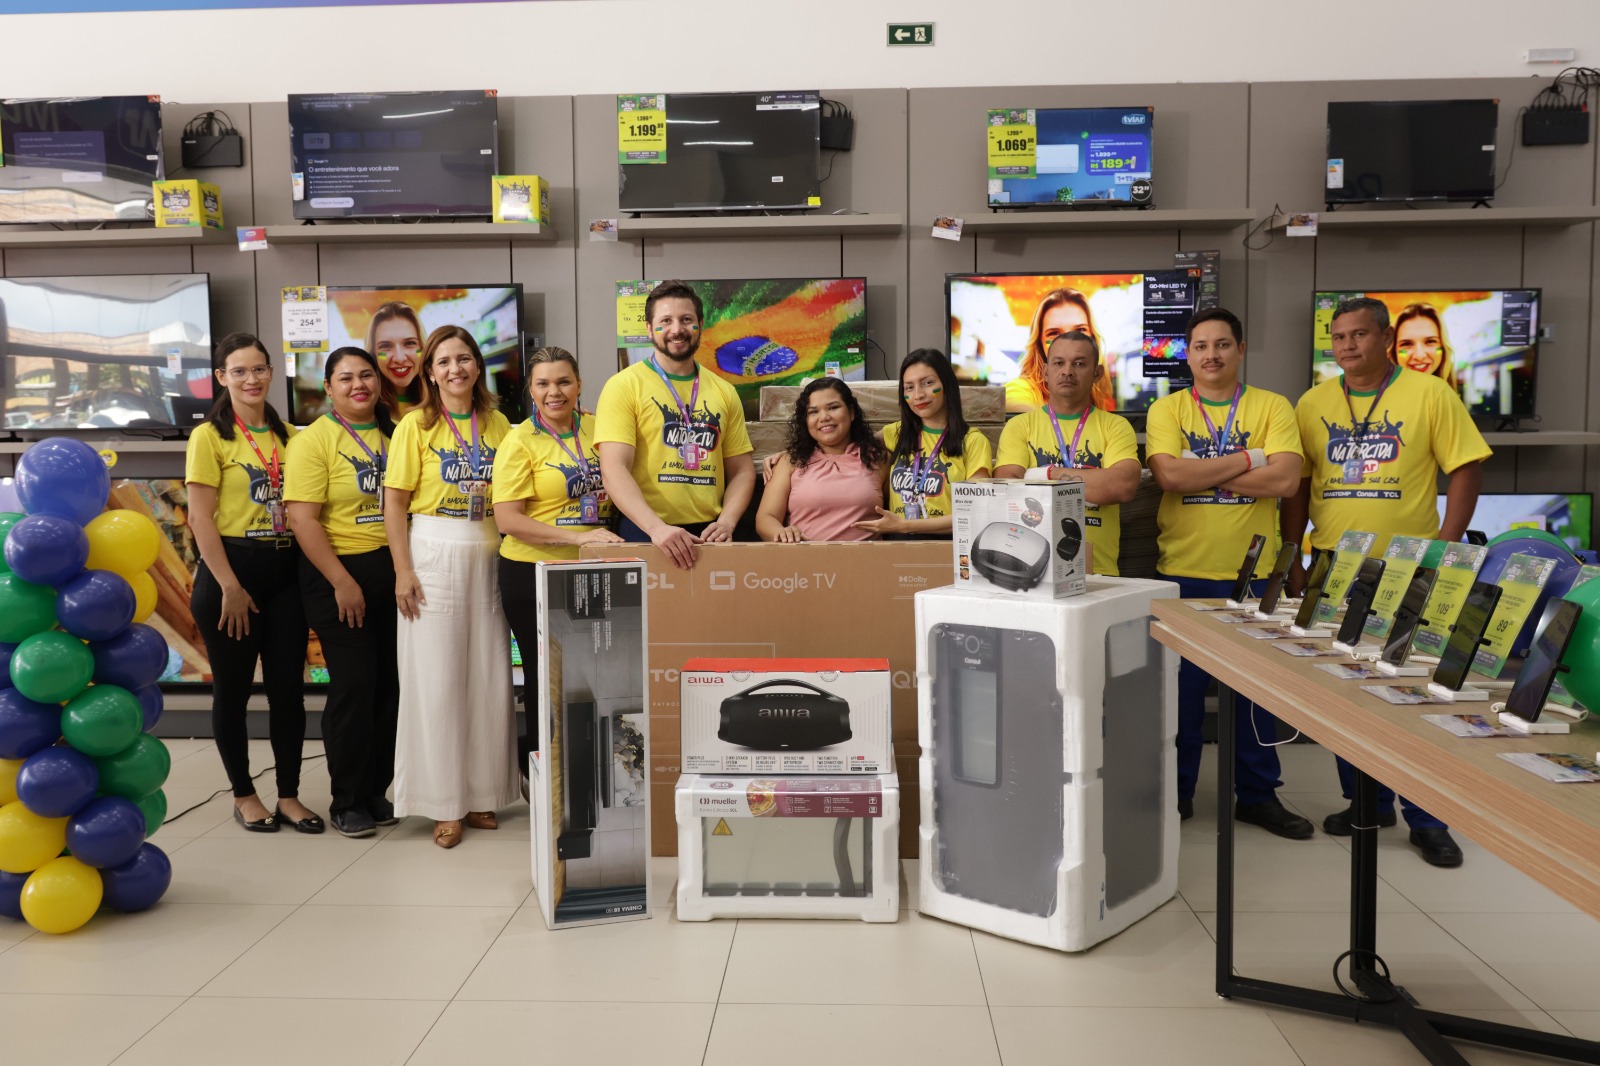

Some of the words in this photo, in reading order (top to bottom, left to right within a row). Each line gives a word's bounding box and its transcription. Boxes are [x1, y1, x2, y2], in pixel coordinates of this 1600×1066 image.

[629, 124, 656, 136] 1.199
[996, 139, 1027, 152] 1.069
[1101, 158, 1123, 169] 189
[445, 464, 460, 481] NA
[363, 474, 376, 491] NA
[255, 484, 268, 501] NA
[955, 487, 996, 497] MONDIAL
[1058, 488, 1081, 497] MONDIAL
[646, 572, 674, 590] CL
[744, 572, 808, 594] Google
[813, 573, 837, 588] TV
[1381, 589, 1394, 601] 119
[1436, 602, 1450, 616] 109
[1496, 619, 1509, 633] 89
[650, 668, 680, 683] TC
[759, 708, 810, 719] aiwa
